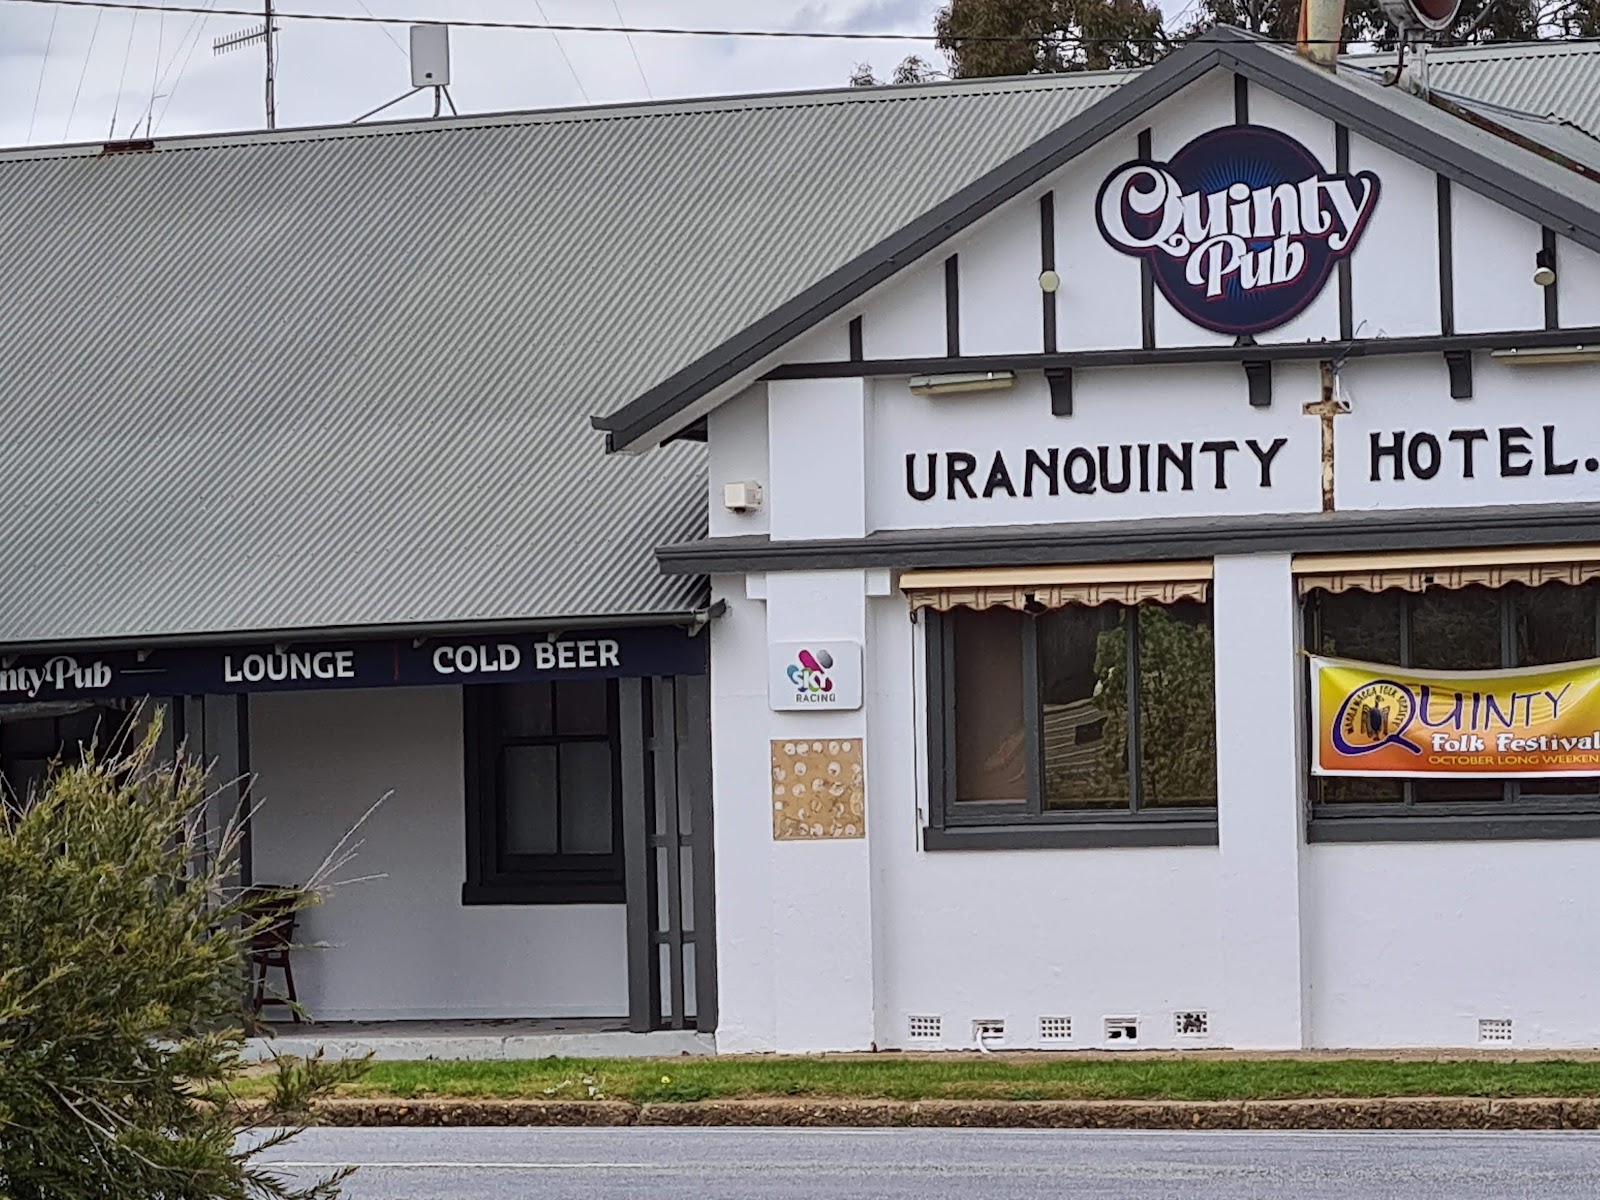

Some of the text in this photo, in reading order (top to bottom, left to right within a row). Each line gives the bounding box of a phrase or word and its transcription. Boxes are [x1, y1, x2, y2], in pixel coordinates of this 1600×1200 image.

[1101, 165, 1372, 257] Quinty
[1185, 234, 1304, 298] Pub
[905, 438, 1289, 501] URANQUINTY
[44, 655, 112, 690] Pub
[224, 651, 355, 682] LOUNGE
[432, 639, 621, 674] COLD BEER
[1332, 679, 1571, 756] QUINTY
[1431, 731, 1600, 752] Folk Festival
[1429, 755, 1495, 765] OCTOBER
[1497, 755, 1540, 765] LONG
